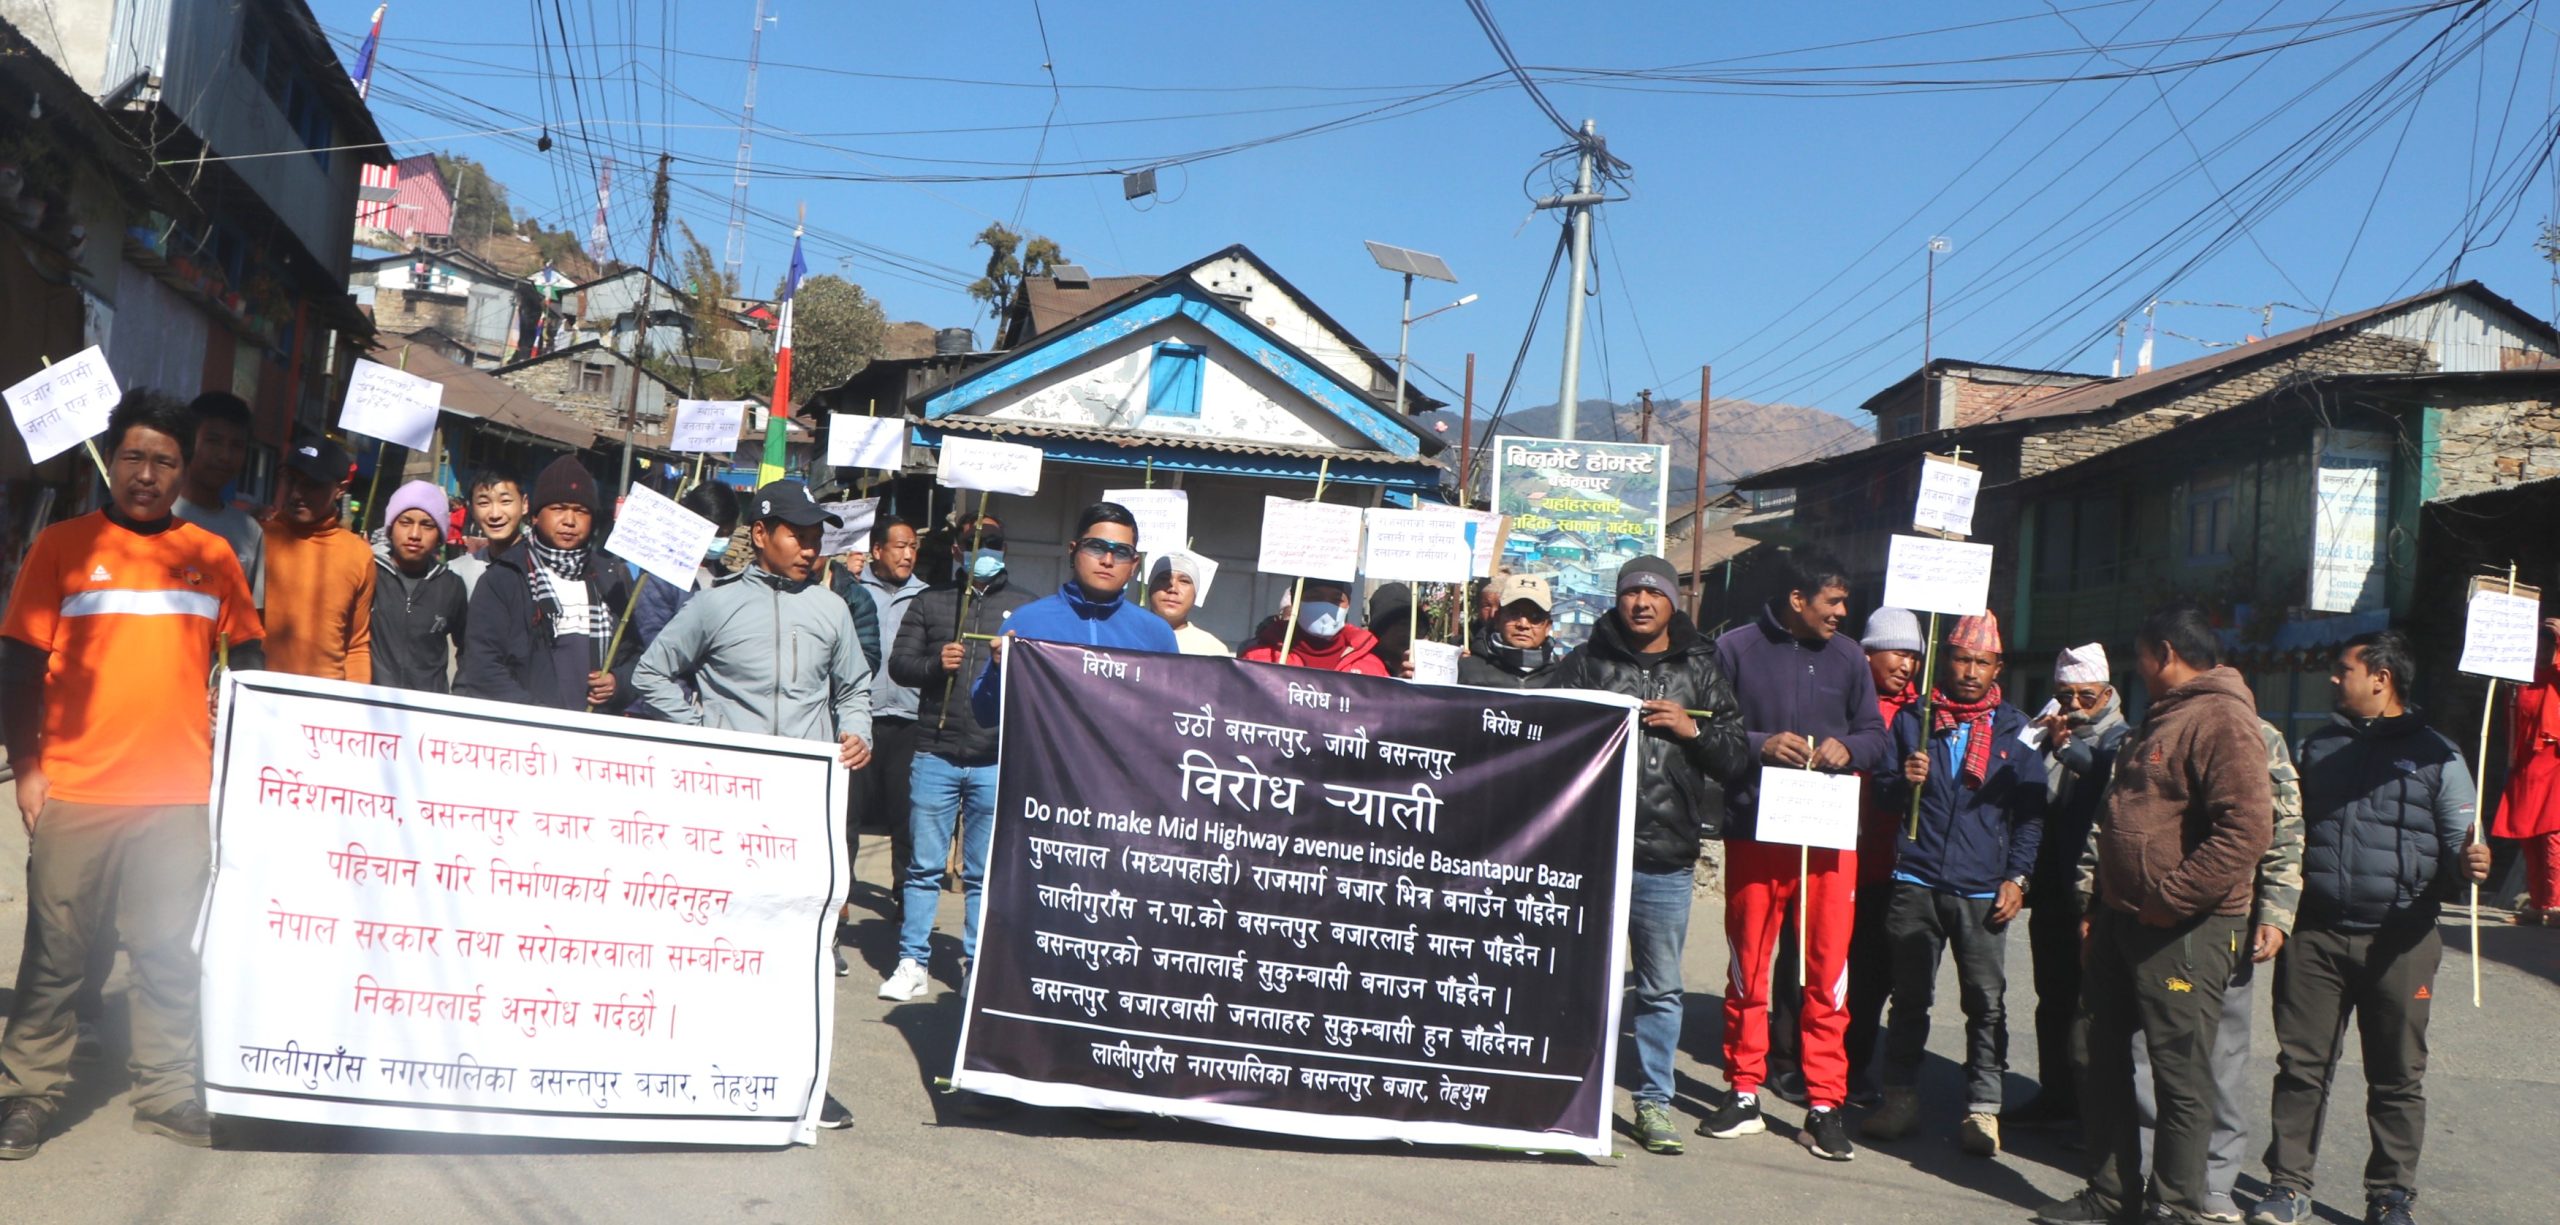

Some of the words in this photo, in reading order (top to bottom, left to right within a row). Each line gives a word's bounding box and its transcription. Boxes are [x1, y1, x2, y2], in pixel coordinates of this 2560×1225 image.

[1548, 475, 1612, 491] बसन्तपुर
[1585, 450, 1654, 474] होमस्टे
[1083, 653, 1126, 679] विरोध
[1288, 683, 1332, 709] विरोध
[1173, 703, 1215, 738] उठौ
[1224, 719, 1312, 759] बसन्तपुर,
[1323, 726, 1370, 760] जागौ
[1378, 741, 1457, 780] बसन्तपुर
[1482, 708, 1525, 737] विरोध
[300, 723, 403, 762] पुष्पलाल
[418, 734, 558, 777] (मध्यपहाडी)
[573, 754, 655, 789] राजमार्ग
[672, 762, 763, 800] आयोजना
[1178, 749, 1306, 816] विरोध
[257, 766, 403, 827] निर्देशनालय,
[416, 800, 520, 847] बसन्तपुर
[739, 824, 798, 868] भूगोल
[1024, 796, 1050, 821] Do
[1055, 806, 1092, 827] not
[1096, 809, 1152, 835] make
[1158, 815, 1198, 841] Mid
[1204, 821, 1289, 857] Highway
[1293, 837, 1364, 862] avenue
[1369, 841, 1425, 870] inside
[1430, 850, 1534, 885] Basantapur
[1537, 863, 1583, 891] Bazar
[327, 842, 422, 887] पहिचान
[434, 853, 476, 892] गरि
[490, 857, 612, 905] निर्माणकार्य
[623, 871, 733, 926] गरिदिनुहुन
[1029, 837, 1110, 869] पुष्पलाल
[1122, 845, 1241, 885] (मध्यपहाडी)
[1251, 865, 1328, 896] राजमार्ग
[1336, 877, 1388, 906] बजार
[1396, 875, 1434, 910] भित्र
[267, 899, 340, 945] नेपाल
[354, 920, 443, 958] सरकार
[455, 928, 504, 959] तथा
[517, 924, 654, 969] सरोकारवाला
[666, 936, 765, 976] सम्बन्धित
[1037, 883, 1138, 923] लालीगुराँस
[1146, 899, 1228, 930] न.पा.को
[1236, 911, 1323, 948] बसन्तपुर
[1330, 922, 1419, 955] बजारलाई
[1427, 934, 1475, 960] मास्न
[1035, 930, 1142, 971] बसन्तपुरको
[1151, 948, 1248, 983] जनतालाई
[1257, 960, 1352, 994] सुकुम्बासी
[1360, 972, 1428, 1000] बनाउन
[354, 974, 486, 1026] निकायलाई
[503, 987, 581, 1038] अनुरोध
[1031, 978, 1109, 1017] बसन्तपुर
[1118, 991, 1218, 1024] बजारबासी
[1227, 1003, 1315, 1036] जनताहरु
[1323, 1014, 1415, 1047] सुकुम्बासी
[1423, 1024, 1454, 1058] हुन
[240, 1040, 367, 1086] लालीगुराँस
[380, 1052, 518, 1093] नगरपालिका
[530, 1067, 622, 1107] बसन्तपुर
[1090, 1040, 1179, 1079] लालीगुराँस
[1187, 1053, 1293, 1086] नगरपालिका
[1300, 1067, 1375, 1102] बसन्तपुर
[1382, 1076, 1428, 1103] बजार,
